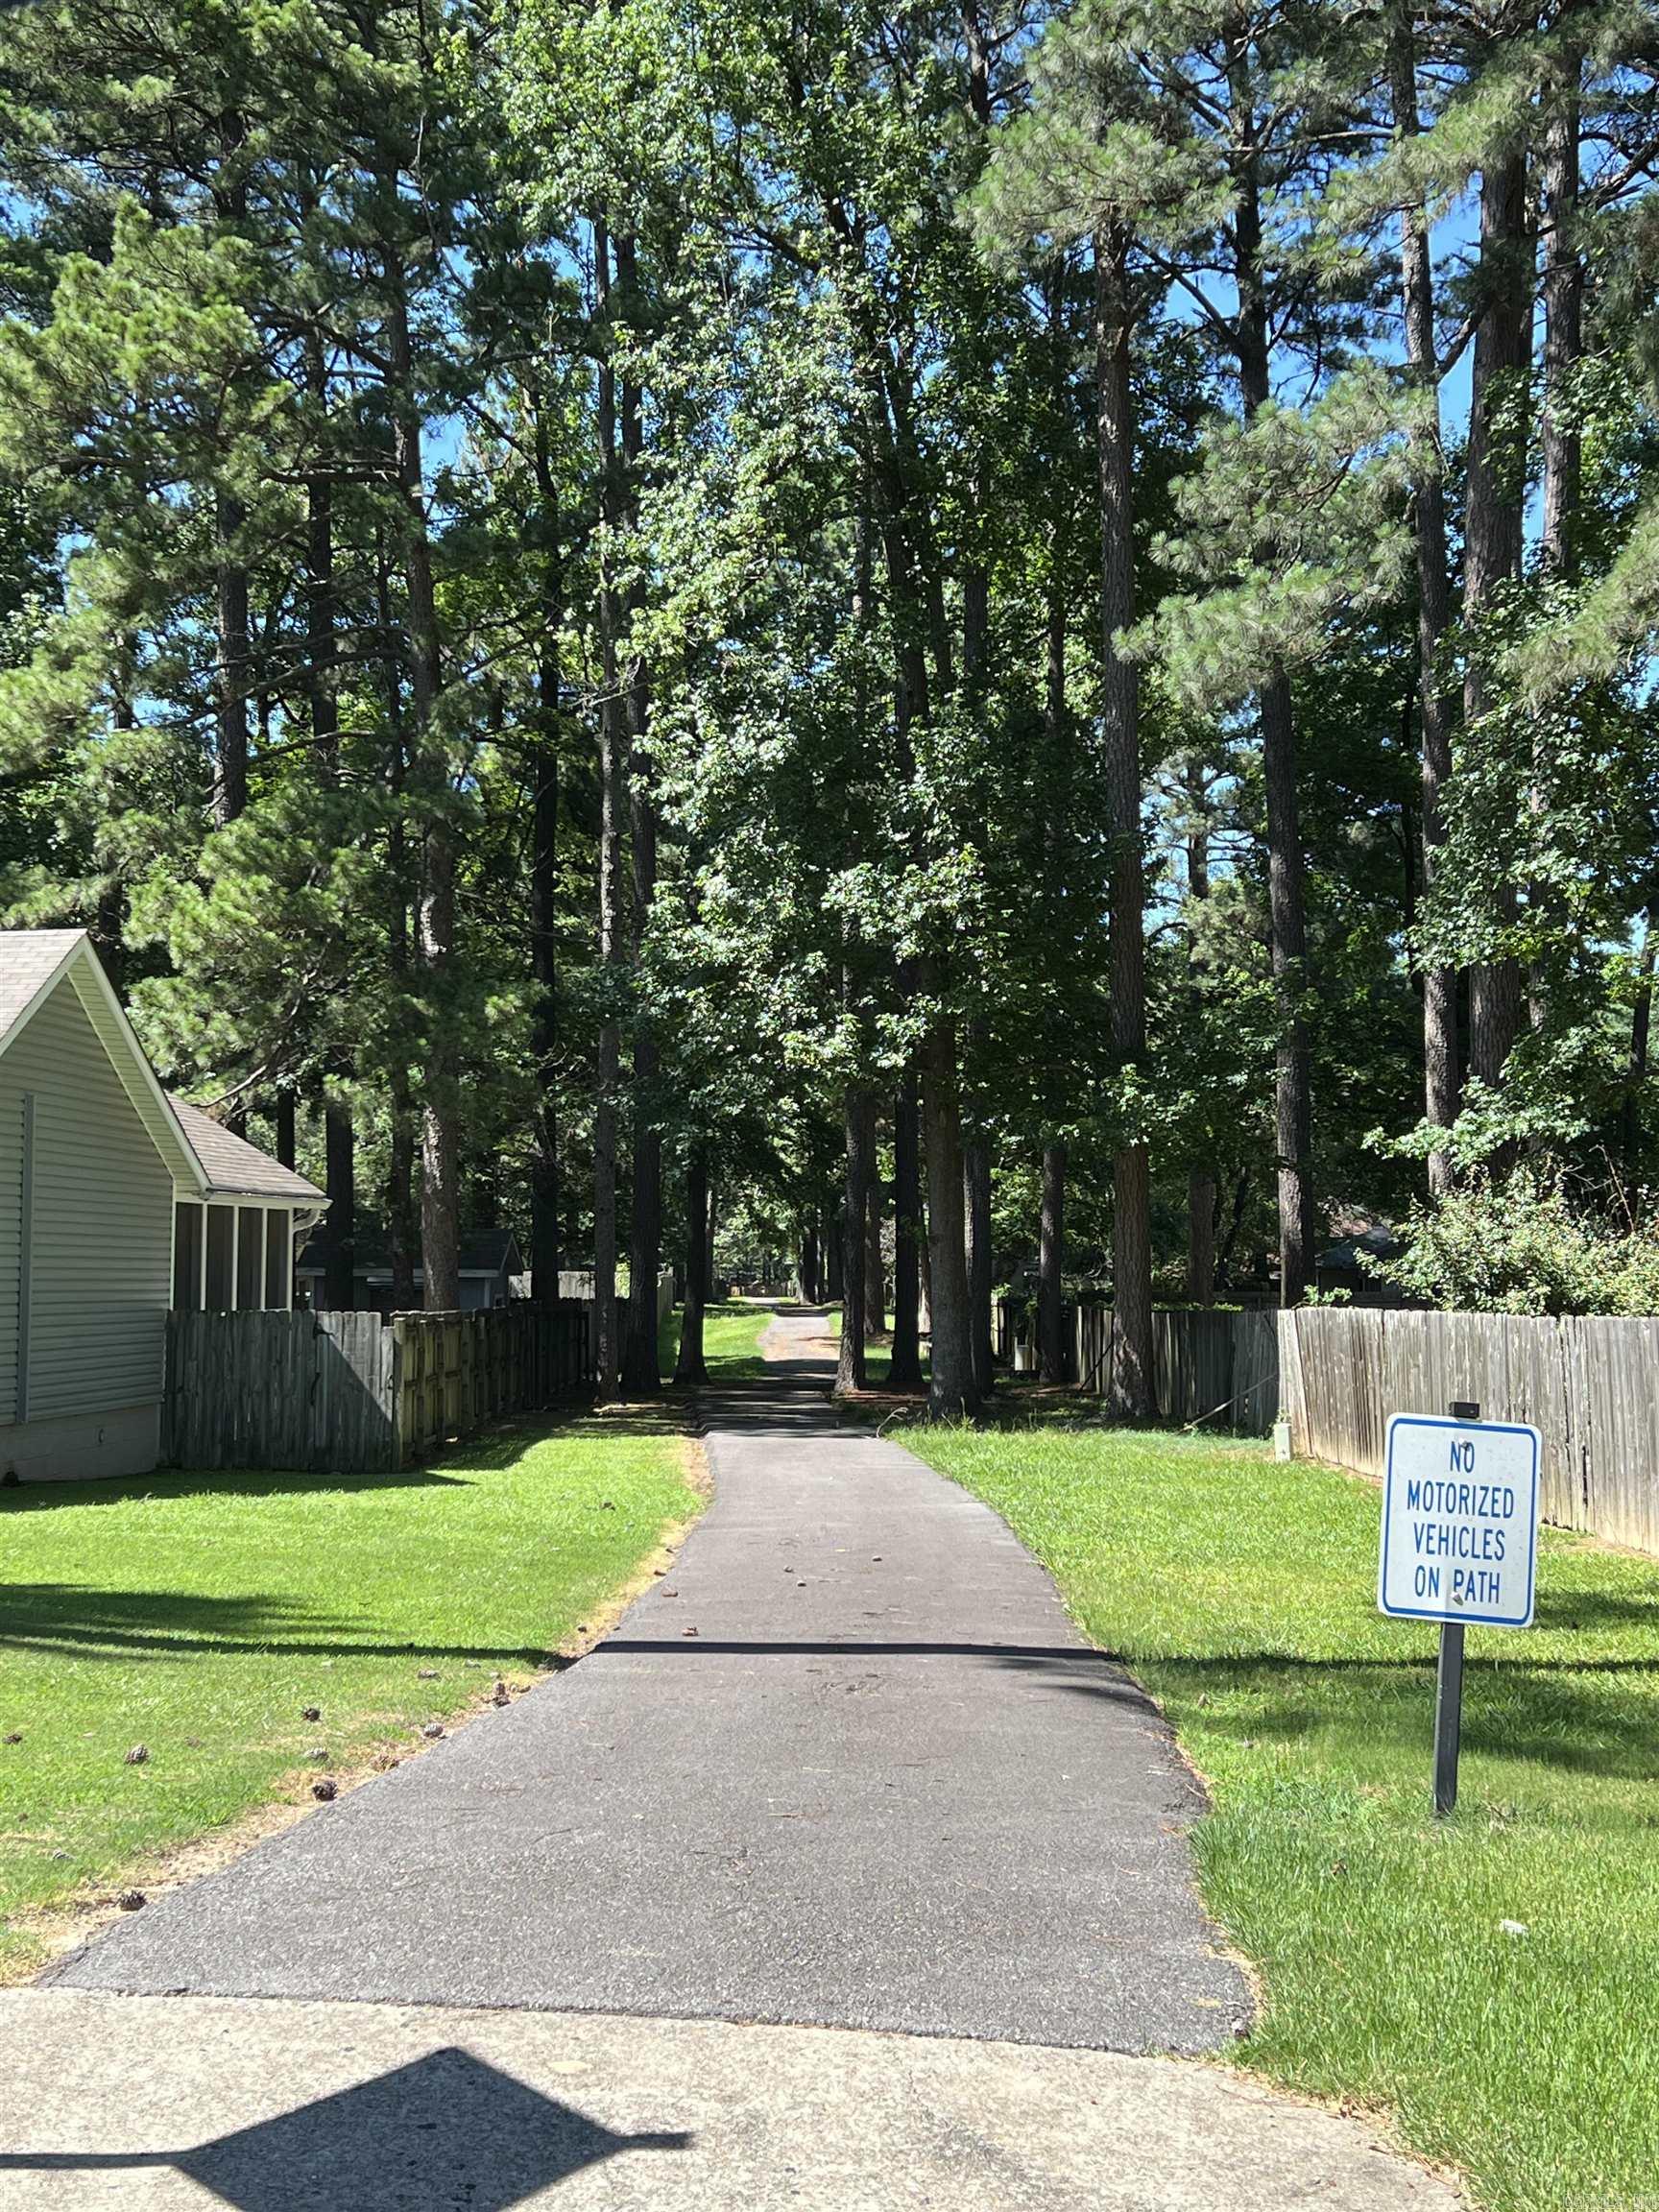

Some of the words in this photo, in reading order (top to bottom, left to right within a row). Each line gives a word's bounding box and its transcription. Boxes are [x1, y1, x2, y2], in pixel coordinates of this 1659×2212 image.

[1450, 1440, 1475, 1474] NO
[1407, 1479, 1514, 1519] MOTORIZED
[1413, 1522, 1505, 1561] VEHICLES
[1414, 1565, 1440, 1598] ON
[1453, 1569, 1501, 1603] PATH
